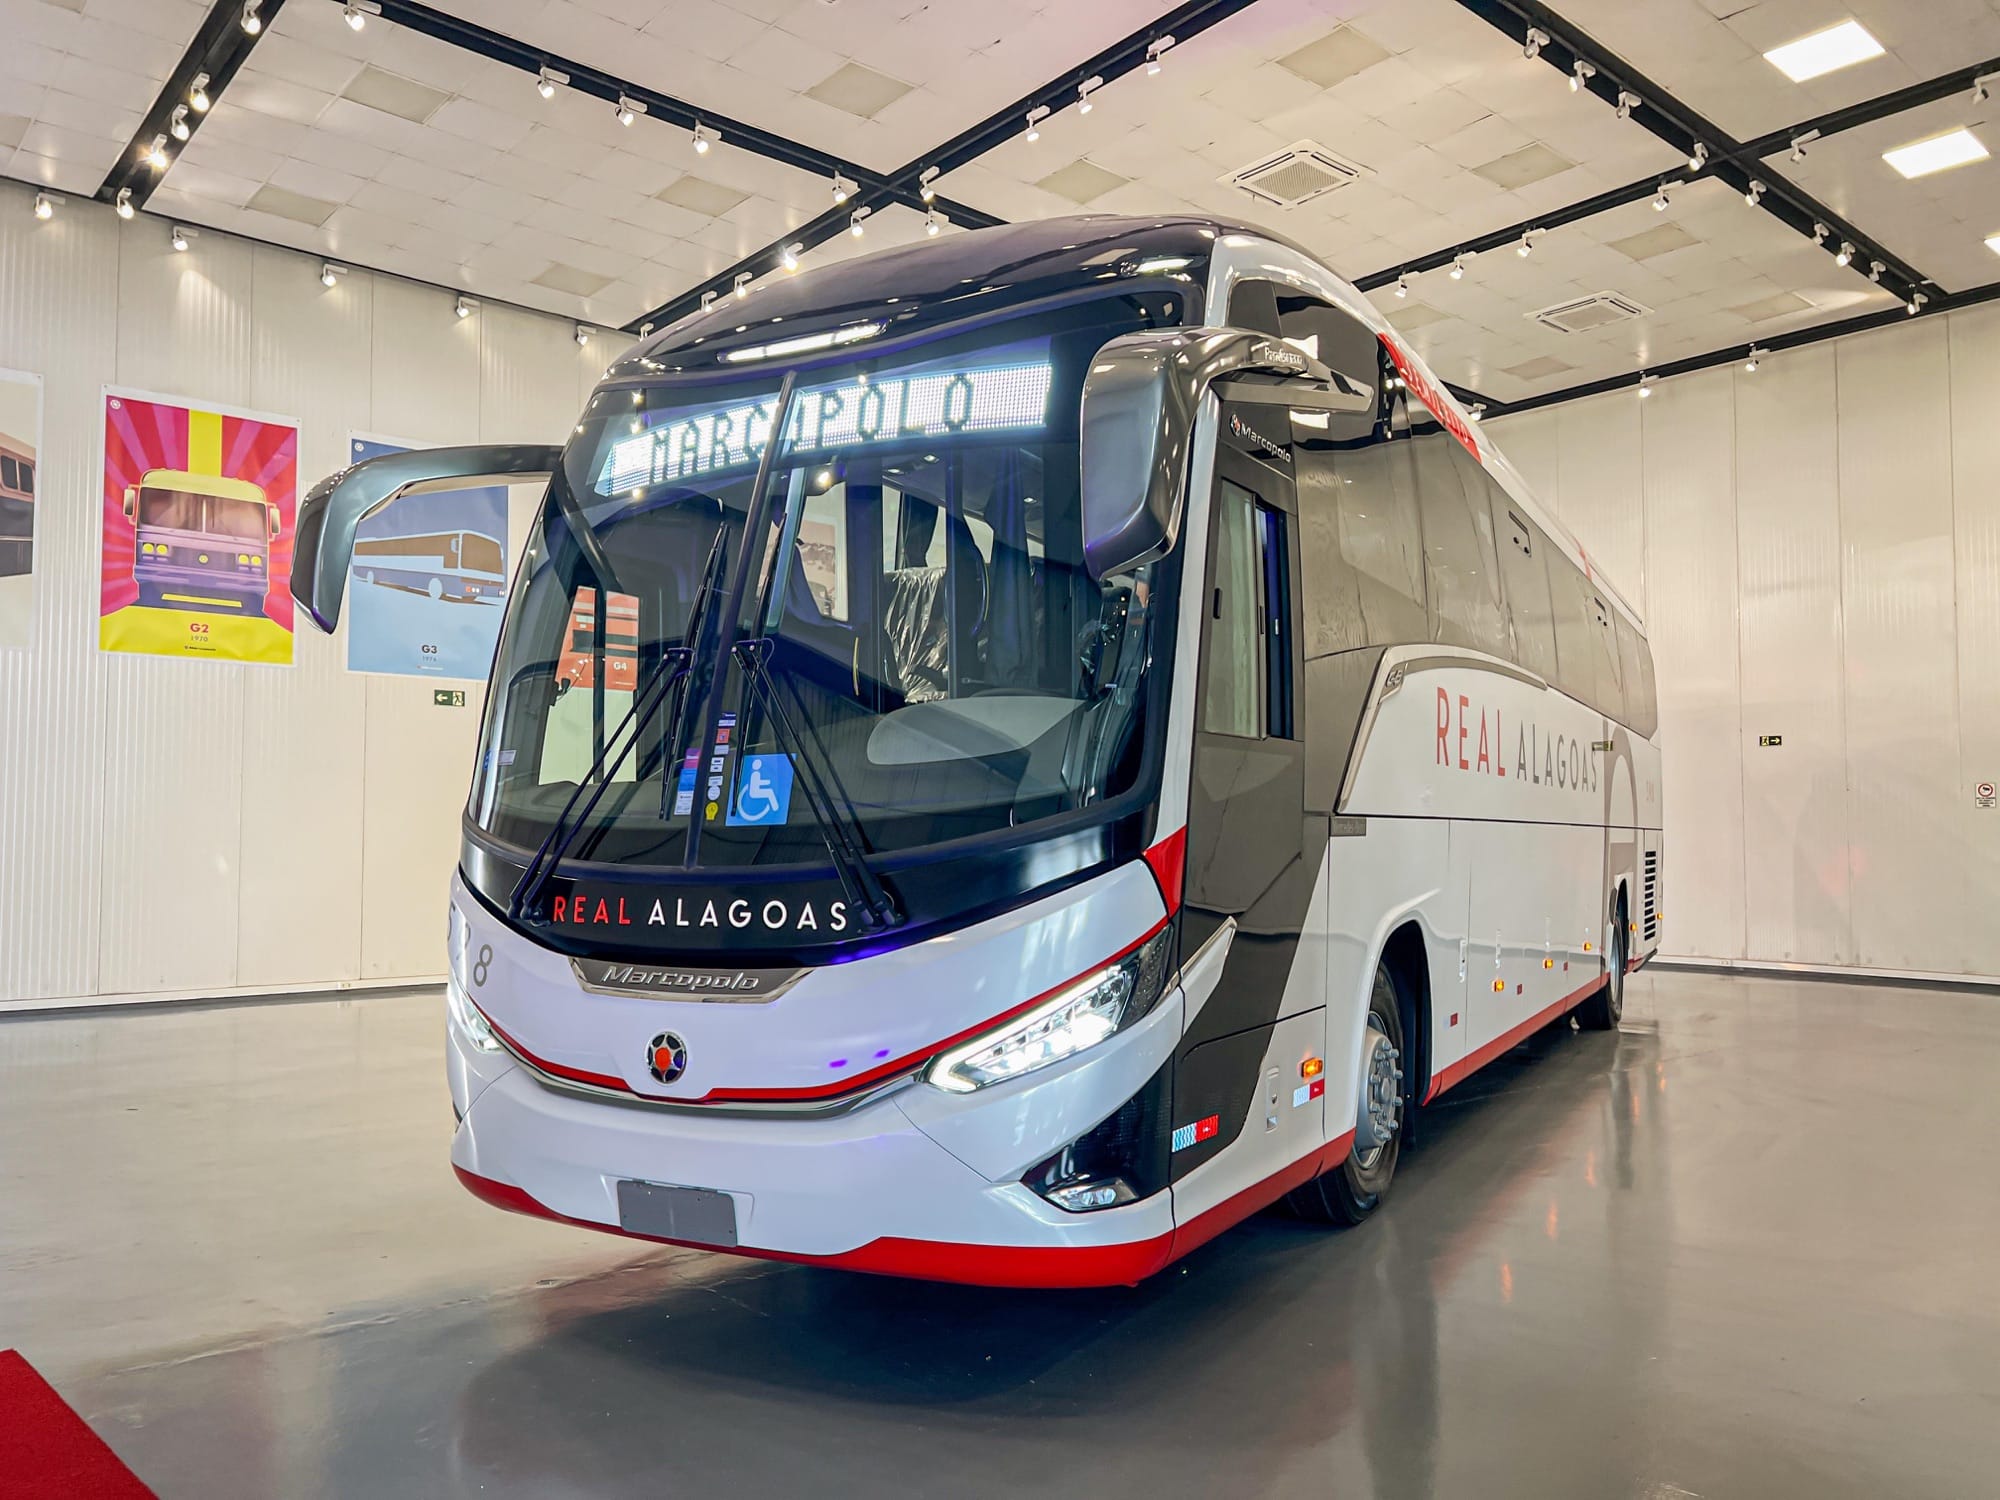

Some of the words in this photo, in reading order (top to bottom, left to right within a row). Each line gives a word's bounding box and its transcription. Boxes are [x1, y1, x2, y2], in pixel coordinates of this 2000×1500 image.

[650, 372, 973, 485] MARCPOLO
[1241, 422, 1292, 463] Marcopolo
[190, 623, 209, 633] G2
[421, 644, 438, 654] G3
[613, 662, 628, 671] G4
[1436, 686, 1506, 776] REAL
[1516, 719, 1597, 793] ALAGOAS
[553, 896, 631, 925] REAL
[648, 898, 848, 931] ALAGOAS
[601, 966, 760, 991] Marcopolo
